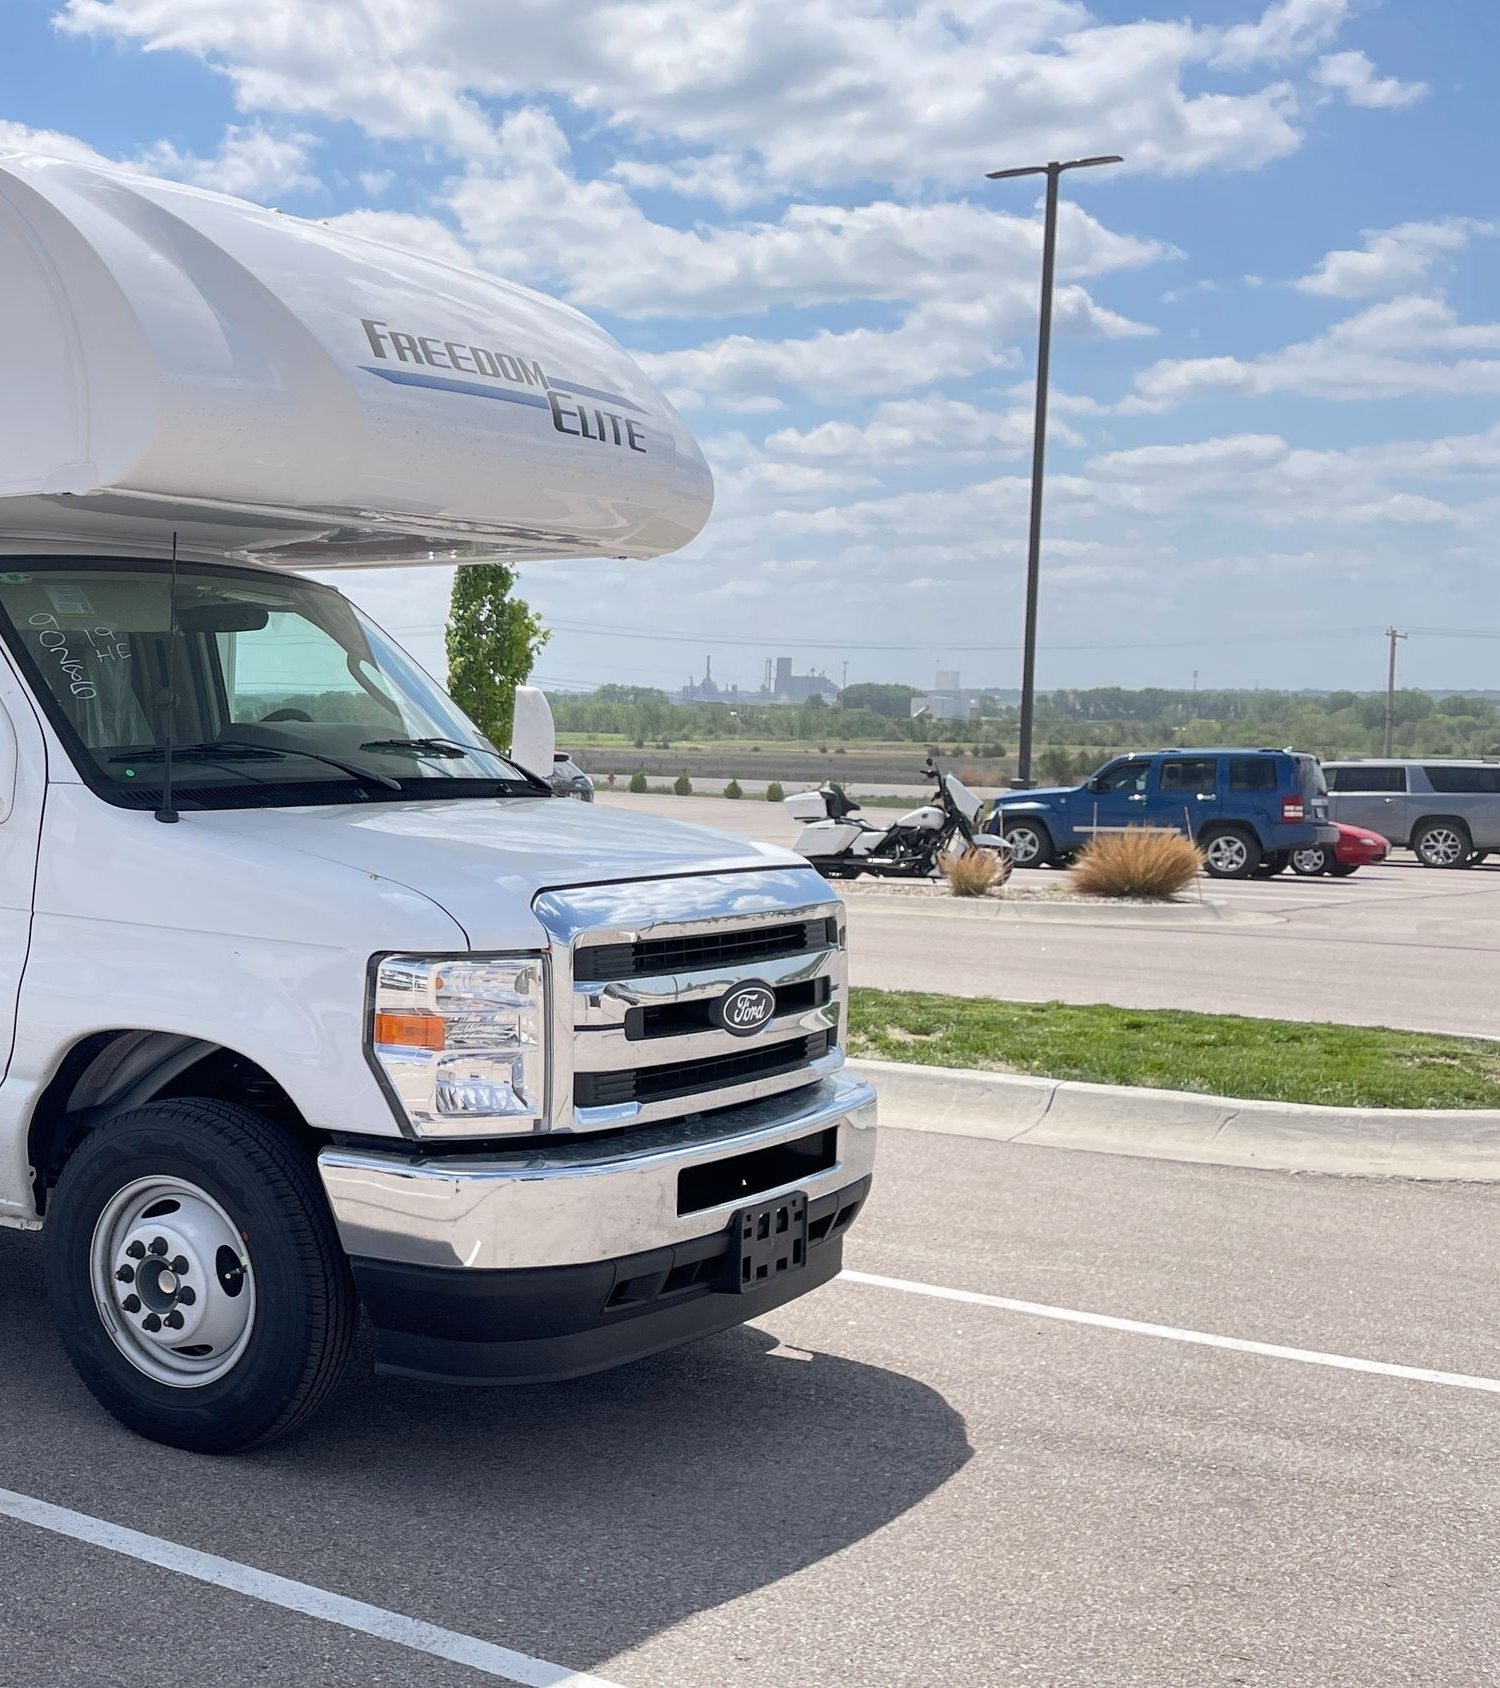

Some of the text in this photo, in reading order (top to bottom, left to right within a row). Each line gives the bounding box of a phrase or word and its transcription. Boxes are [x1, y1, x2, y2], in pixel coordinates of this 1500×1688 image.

[360, 318, 549, 390] FREEDOM
[546, 390, 647, 453] ELITE
[733, 993, 766, 1023] Ford
